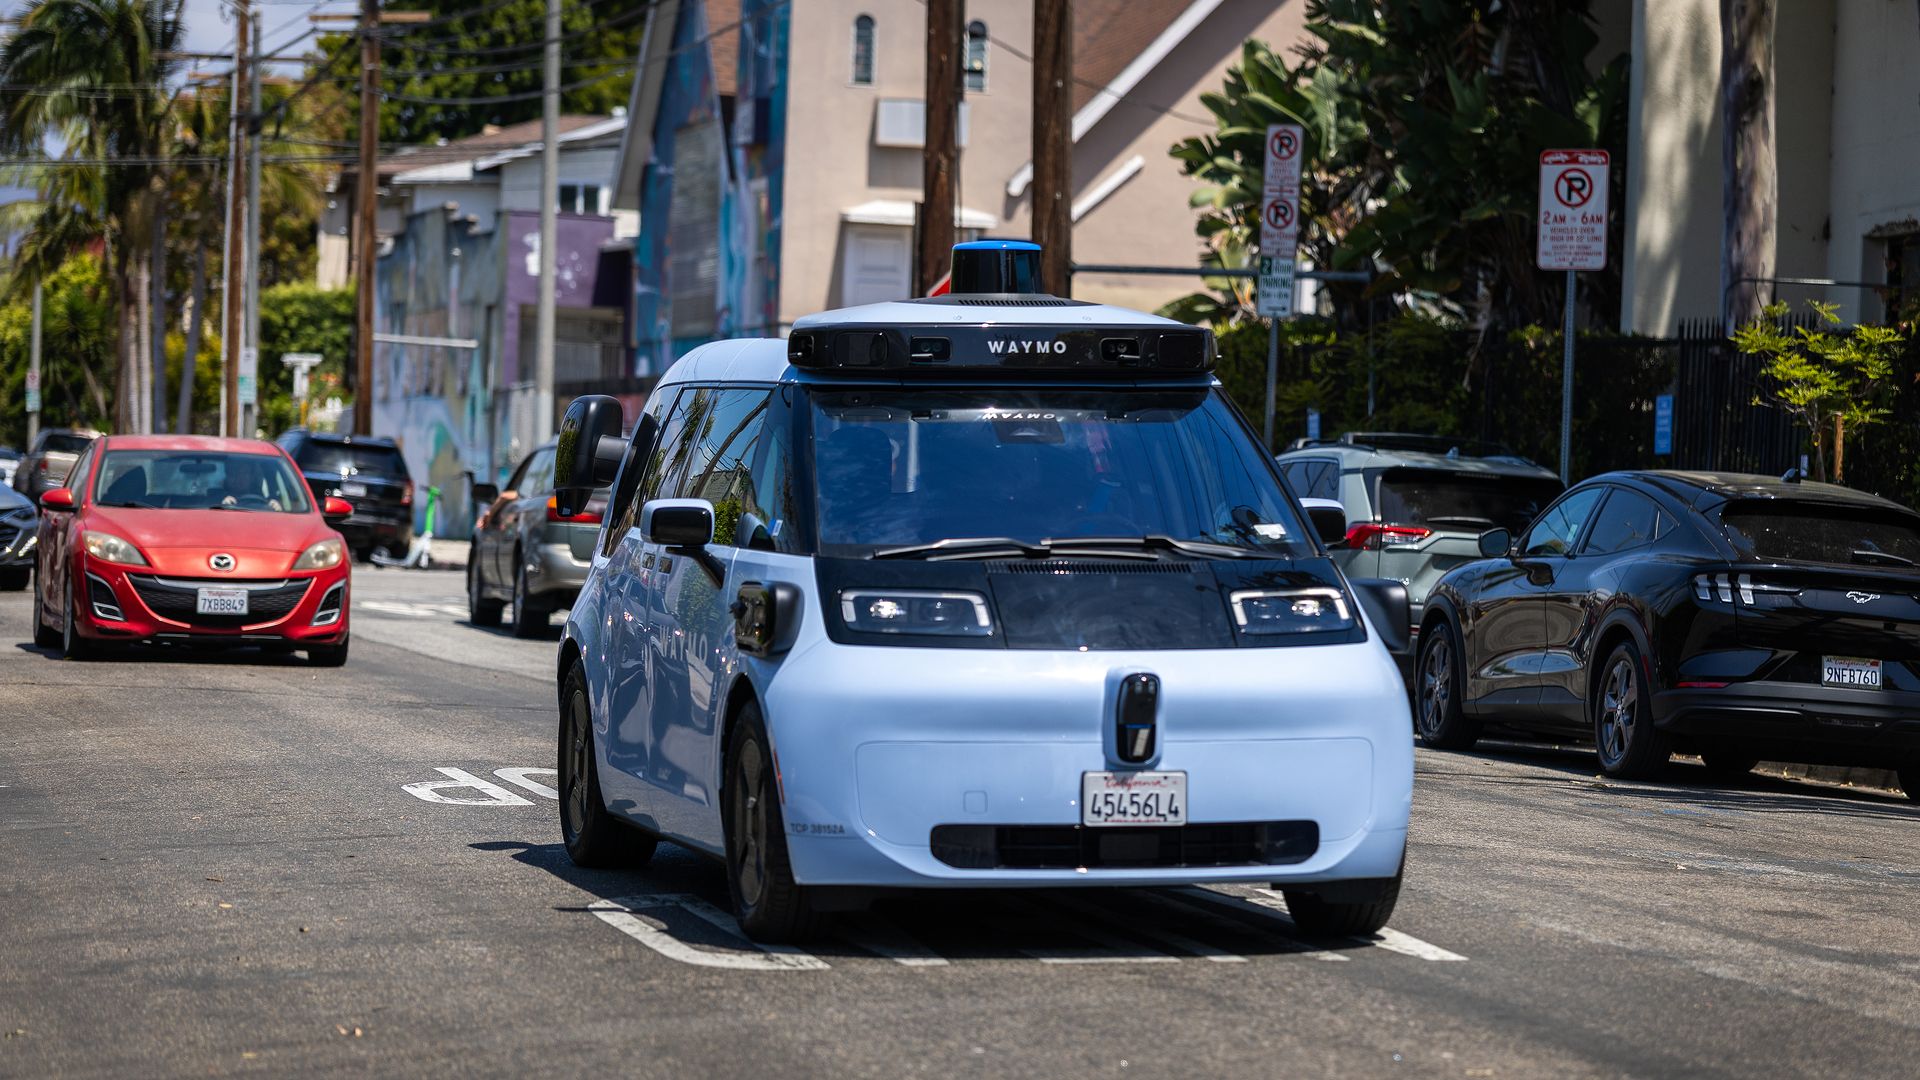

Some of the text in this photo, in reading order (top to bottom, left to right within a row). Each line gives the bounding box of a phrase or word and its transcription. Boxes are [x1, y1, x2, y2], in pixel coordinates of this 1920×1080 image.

[1581, 211, 1603, 224] 6AM
[987, 340, 1067, 354] WAYMO
[201, 598, 245, 611] 7XBB849
[659, 624, 708, 665] WAYMO
[1827, 667, 1877, 684] 9NFB760
[1091, 793, 1179, 817] 45456L4
[790, 822, 809, 833] TCP
